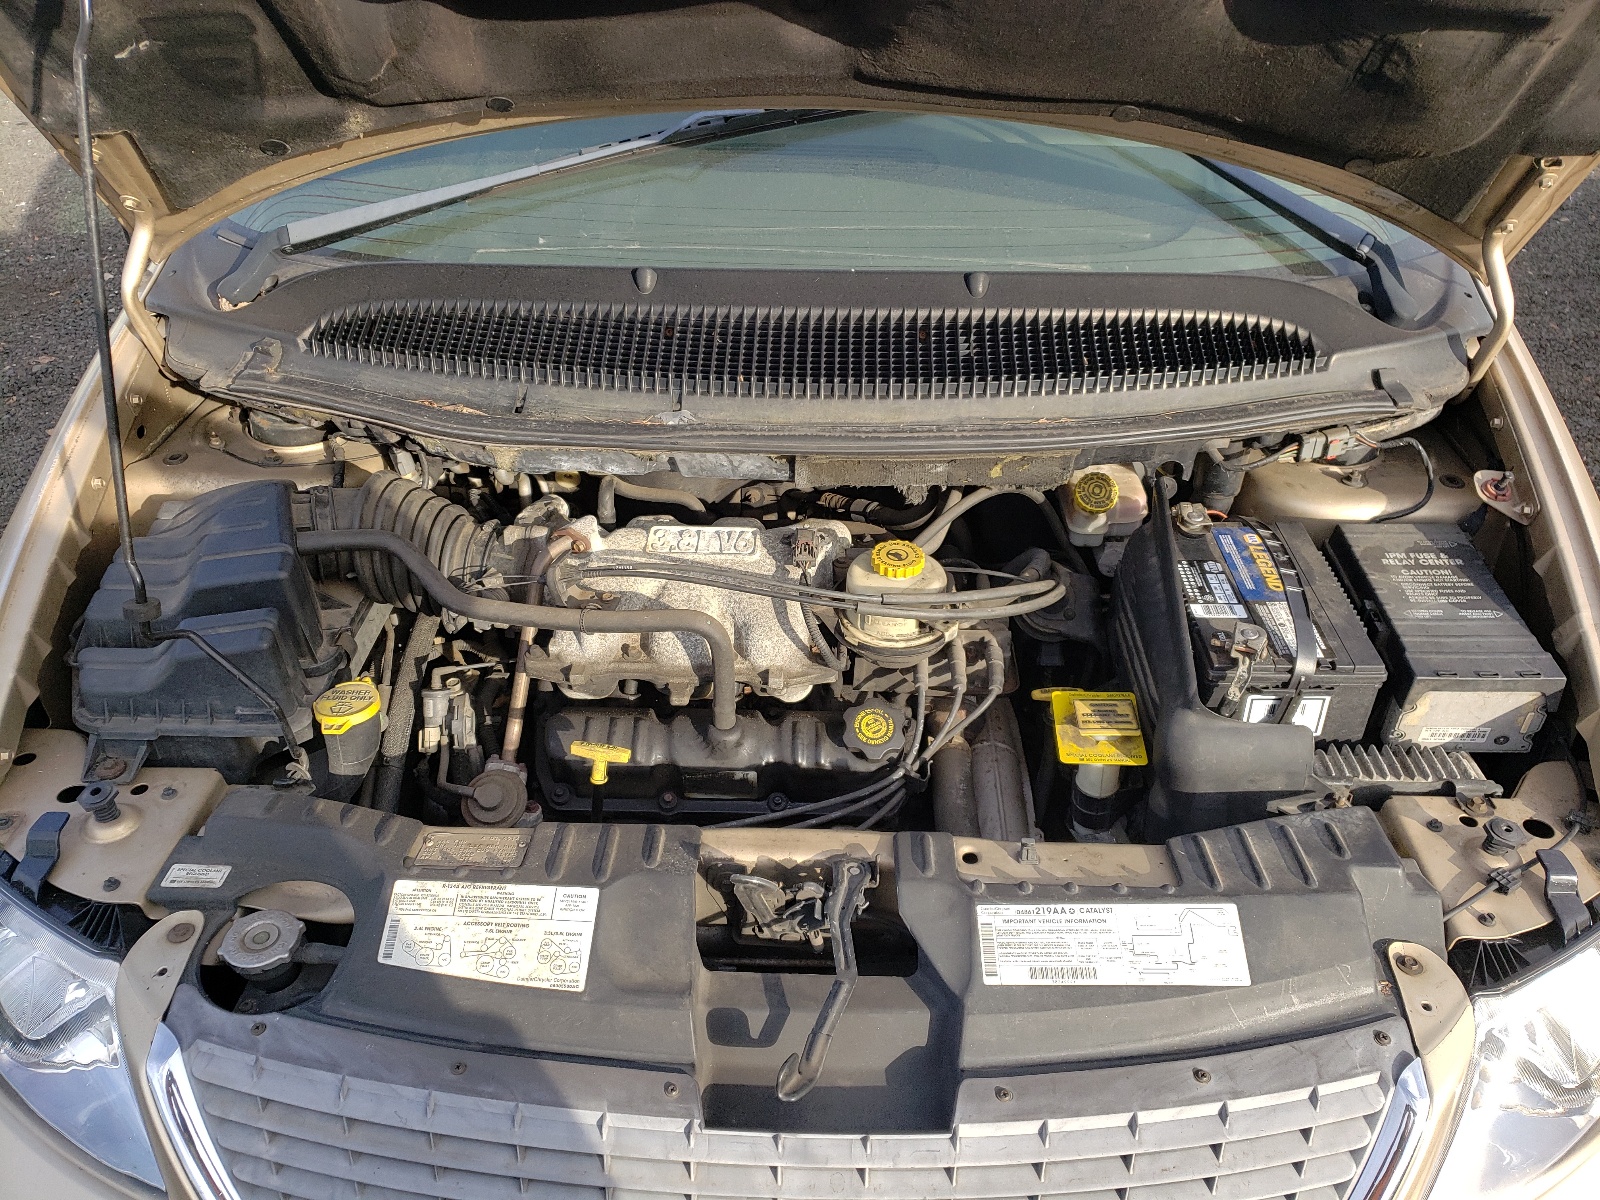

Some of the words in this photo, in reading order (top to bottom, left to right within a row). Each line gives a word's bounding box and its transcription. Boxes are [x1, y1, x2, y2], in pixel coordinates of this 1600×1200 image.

[1381, 558, 1416, 566] RELAY
[1248, 545, 1284, 592] LEGEND
[1078, 906, 1113, 914] CATALYST
